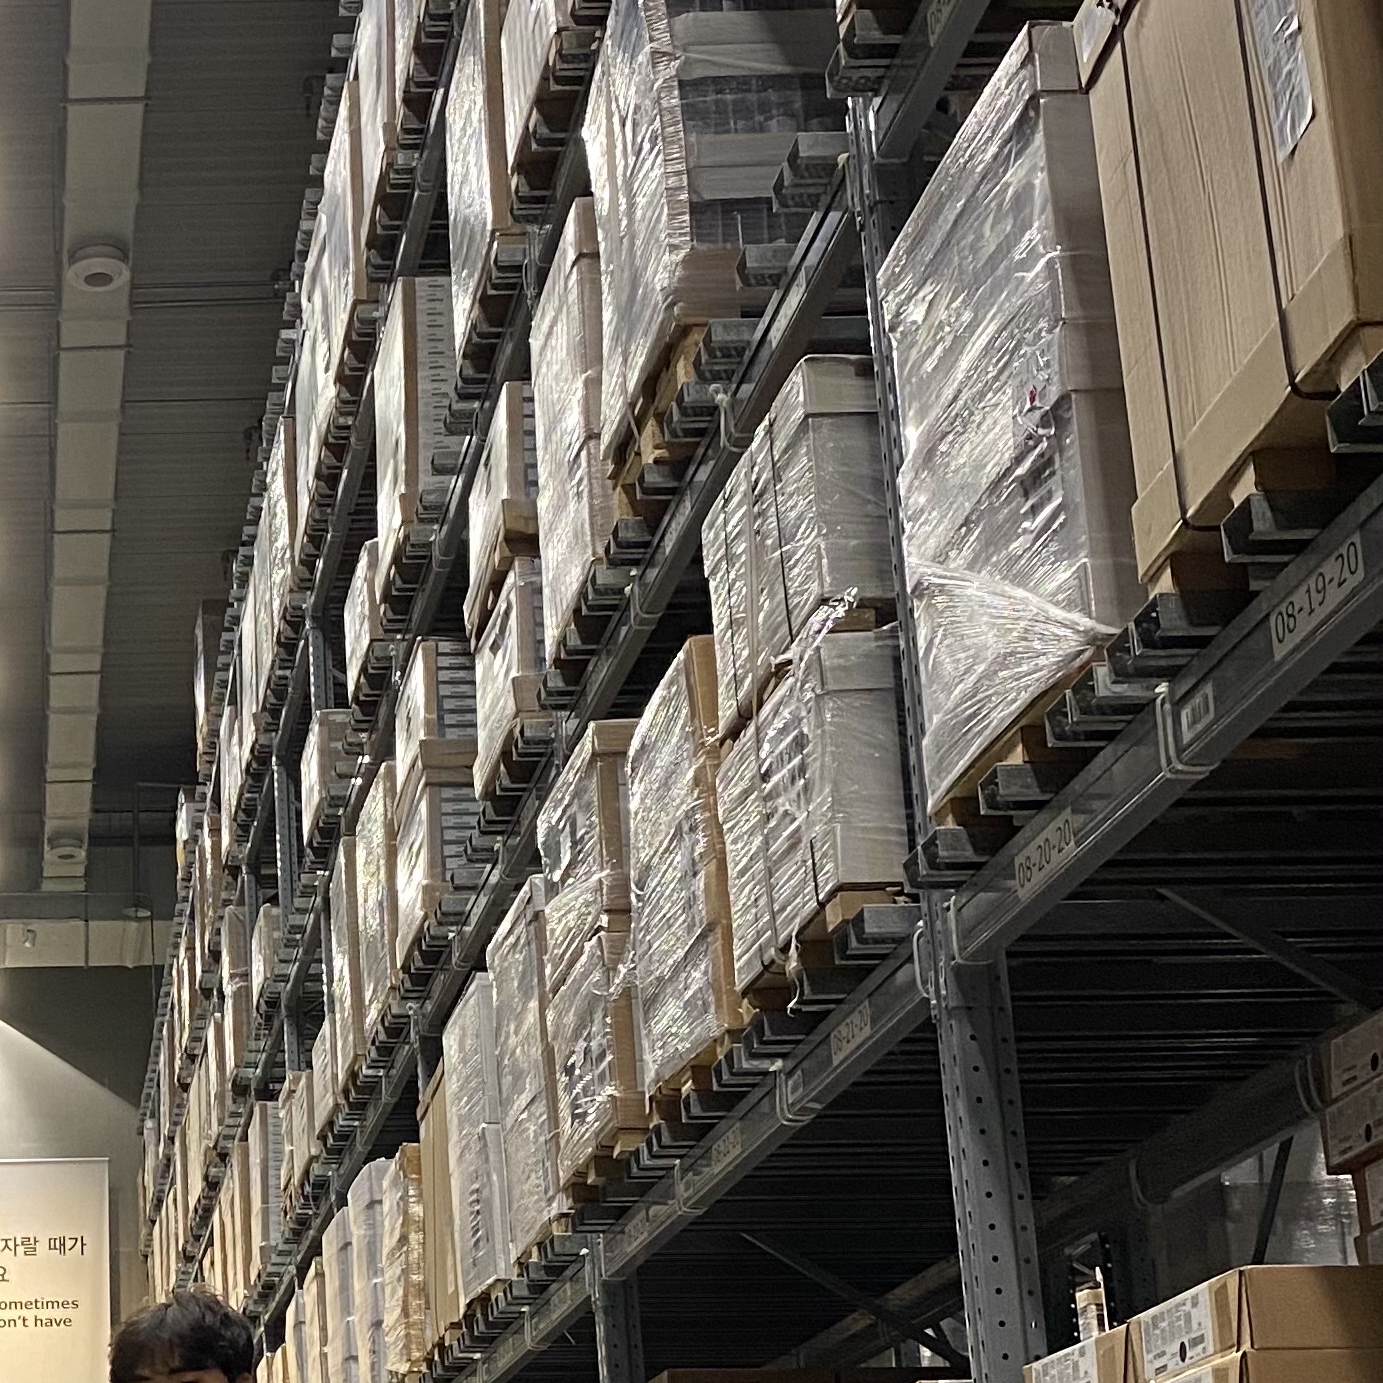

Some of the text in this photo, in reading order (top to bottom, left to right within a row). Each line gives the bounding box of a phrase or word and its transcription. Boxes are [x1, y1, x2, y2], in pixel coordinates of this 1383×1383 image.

[1274, 540, 1359, 644] 08-19-20
[1017, 818, 1072, 888] 08-20-20
[48, 1234, 87, 1257] 때가
[33, 1314, 73, 1328] have
